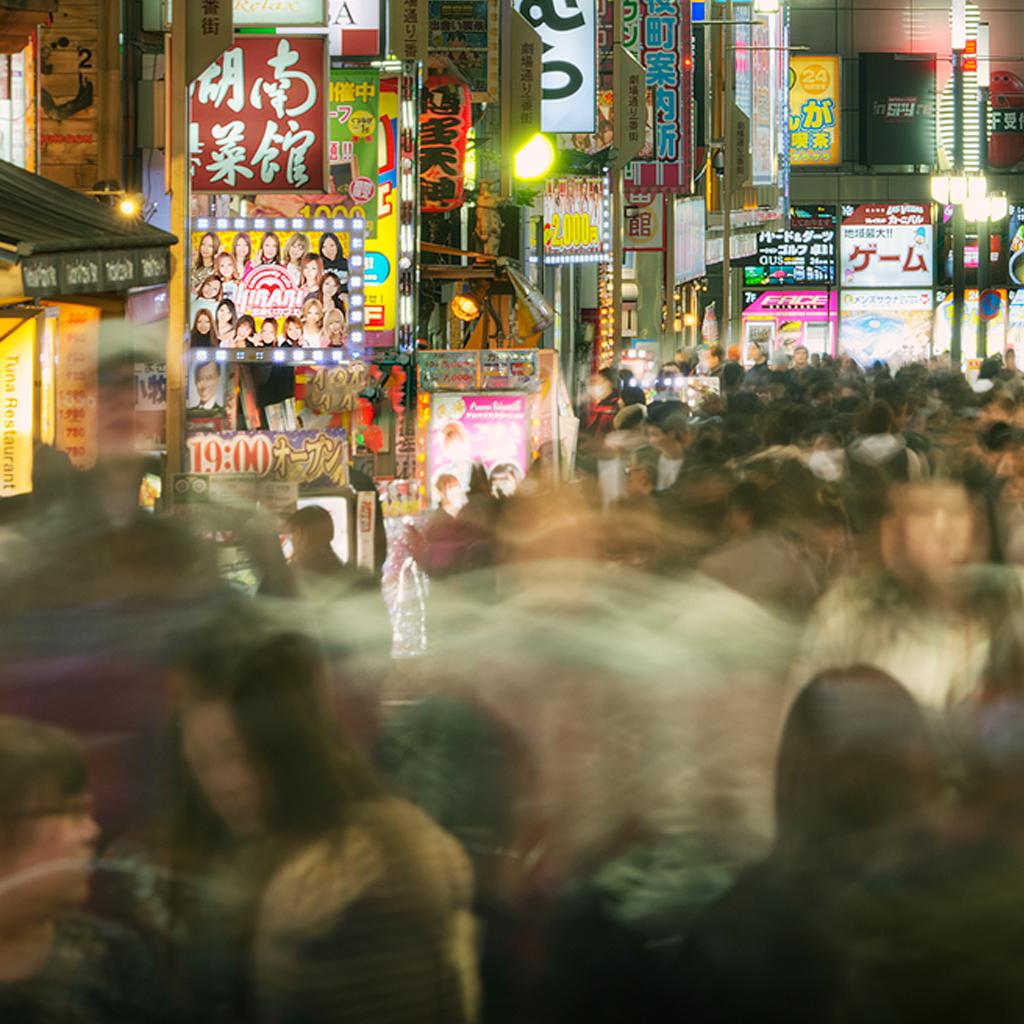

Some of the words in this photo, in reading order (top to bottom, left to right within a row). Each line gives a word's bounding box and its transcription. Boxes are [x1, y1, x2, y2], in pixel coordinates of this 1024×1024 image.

[550, 211, 599, 251] 2,000円
[848, 243, 929, 273] ゲーム
[761, 295, 829, 305] FACE
[4, 353, 21, 393] Tuna
[3, 397, 19, 491] Restaurant
[189, 433, 273, 476] 19:00
[272, 432, 344, 477] オープン
